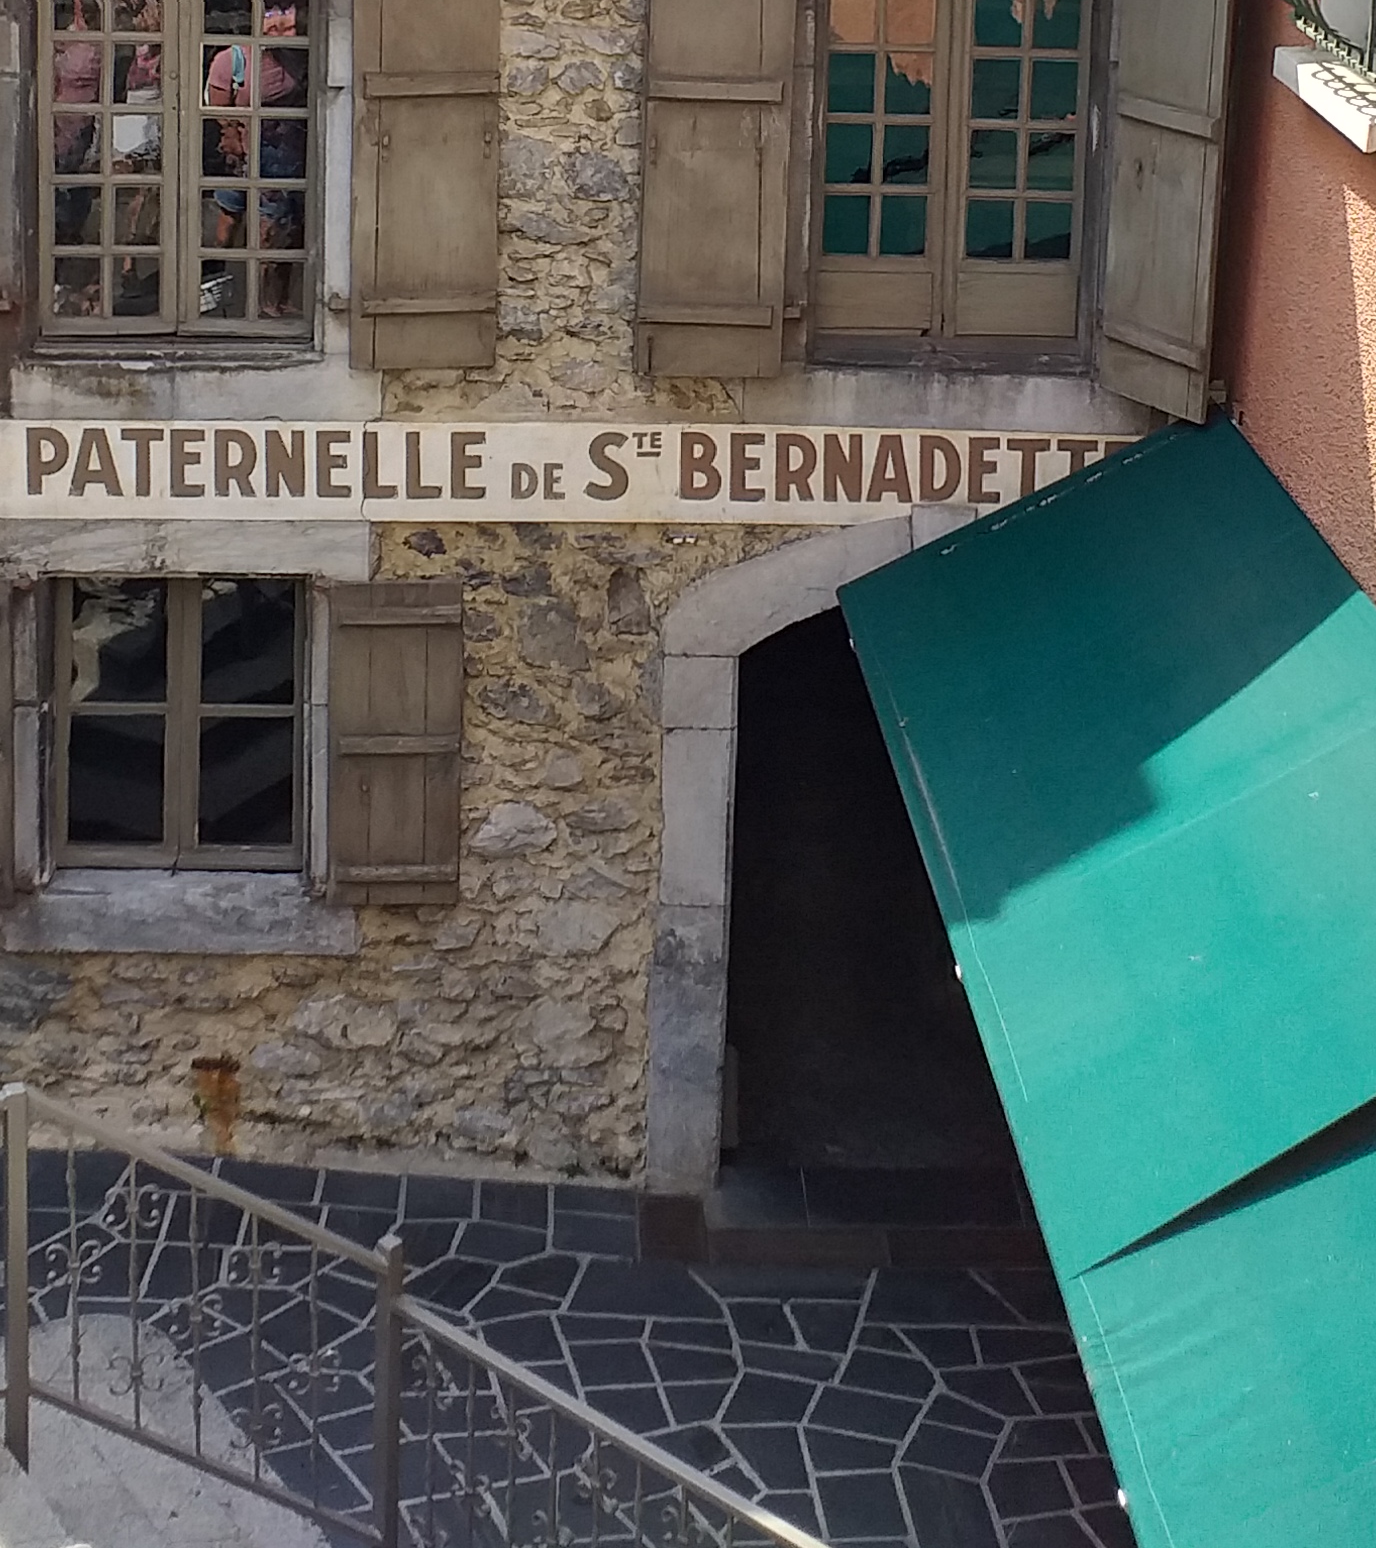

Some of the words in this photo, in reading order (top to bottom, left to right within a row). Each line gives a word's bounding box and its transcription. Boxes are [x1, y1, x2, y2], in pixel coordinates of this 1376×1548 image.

[25, 426, 487, 500] PATERNELLE
[510, 462, 565, 501] DE
[679, 431, 1138, 505] BERNADETT
